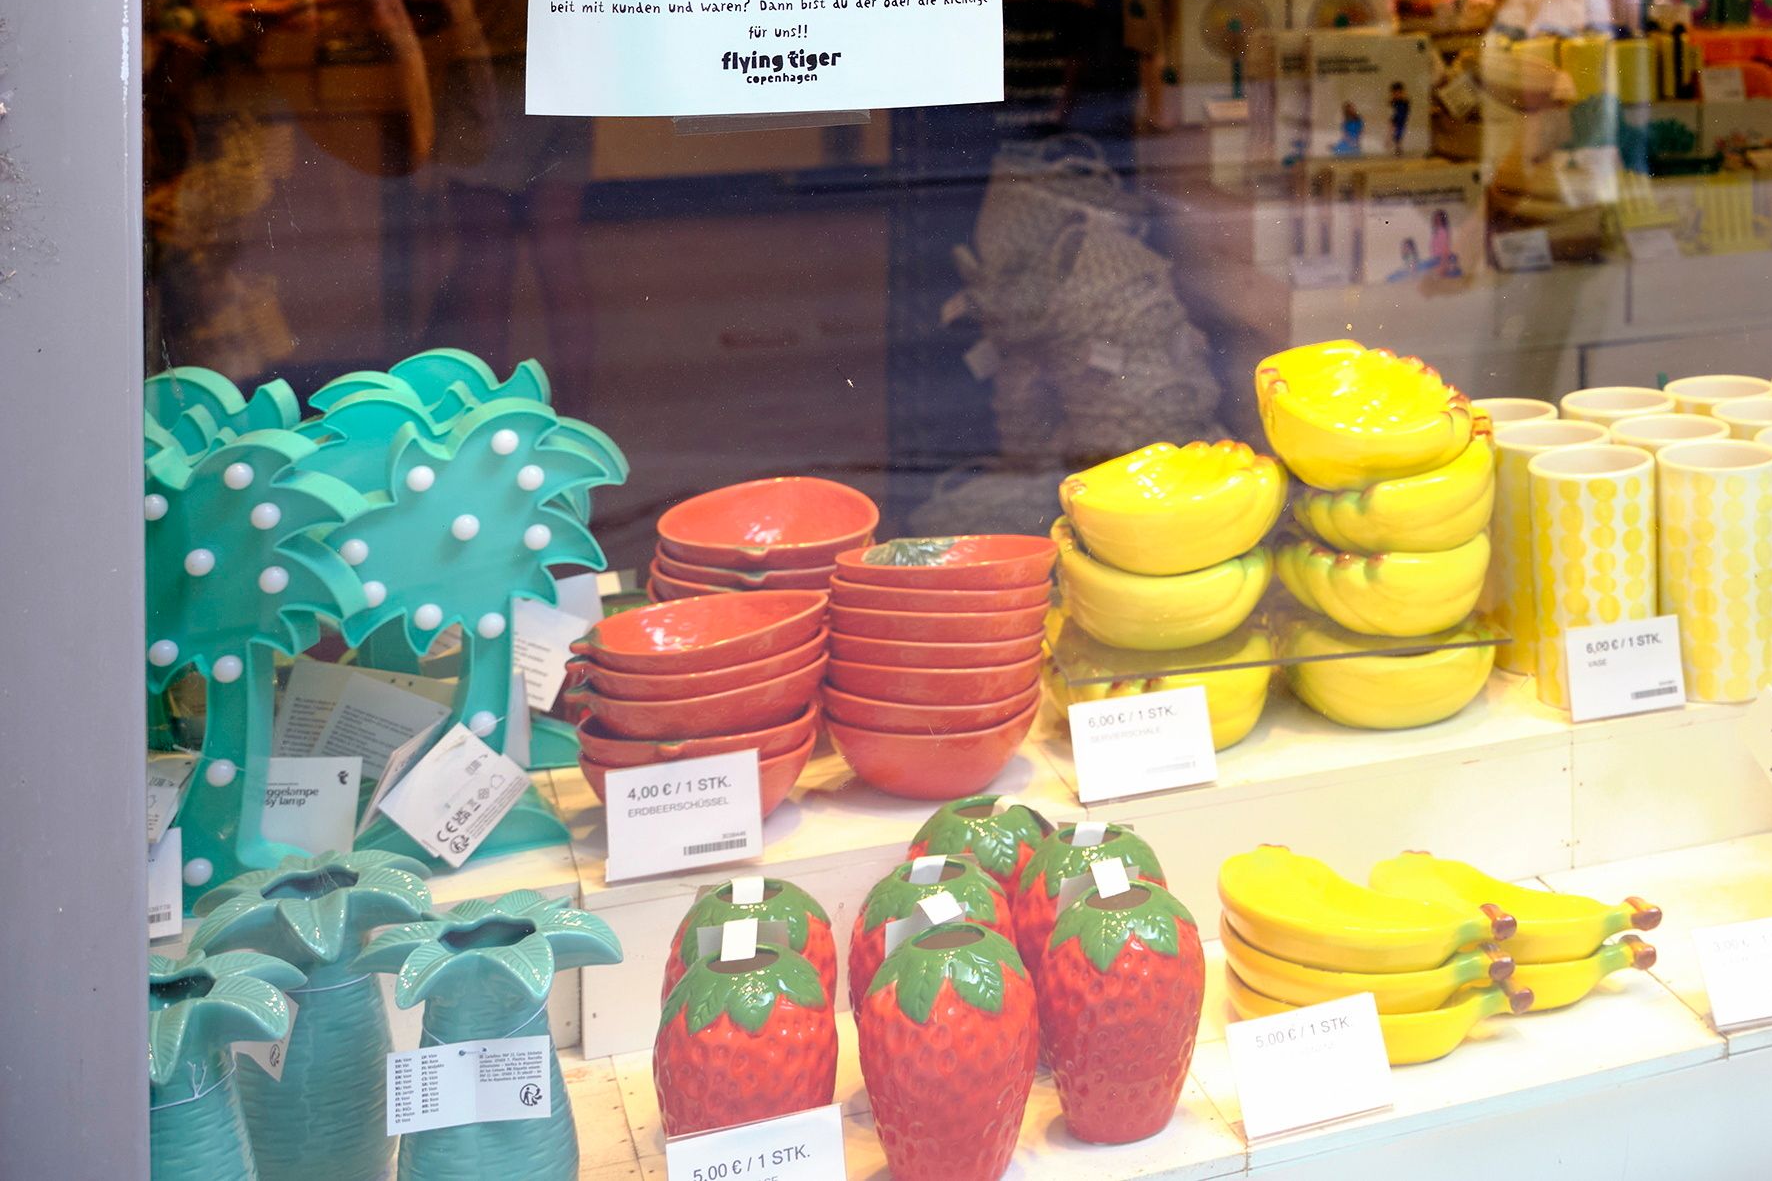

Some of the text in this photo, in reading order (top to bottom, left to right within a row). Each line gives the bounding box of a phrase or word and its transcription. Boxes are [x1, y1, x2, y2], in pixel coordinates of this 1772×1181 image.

[550, 0, 576, 14] beit
[581, 0, 605, 14] mit
[668, 0, 694, 14] und
[759, 0, 794, 12] Dann
[748, 23, 808, 40] für uns!!
[720, 48, 842, 75] flying tiger
[745, 72, 818, 86] copenhagen
[1586, 640, 1610, 655] 6,00
[1611, 639, 1619, 650] €
[1088, 714, 1115, 729] 6,00
[1118, 712, 1126, 724] €
[627, 785, 660, 802] 4,00
[662, 783, 673, 796] €
[685, 781, 693, 792] 1
[697, 775, 732, 792] STK.
[628, 796, 729, 818] ERDBEERSCHÜSSEL
[693, 1163, 728, 1181] 5,00
[731, 1159, 742, 1175] €
[771, 1144, 811, 1166] STK.
